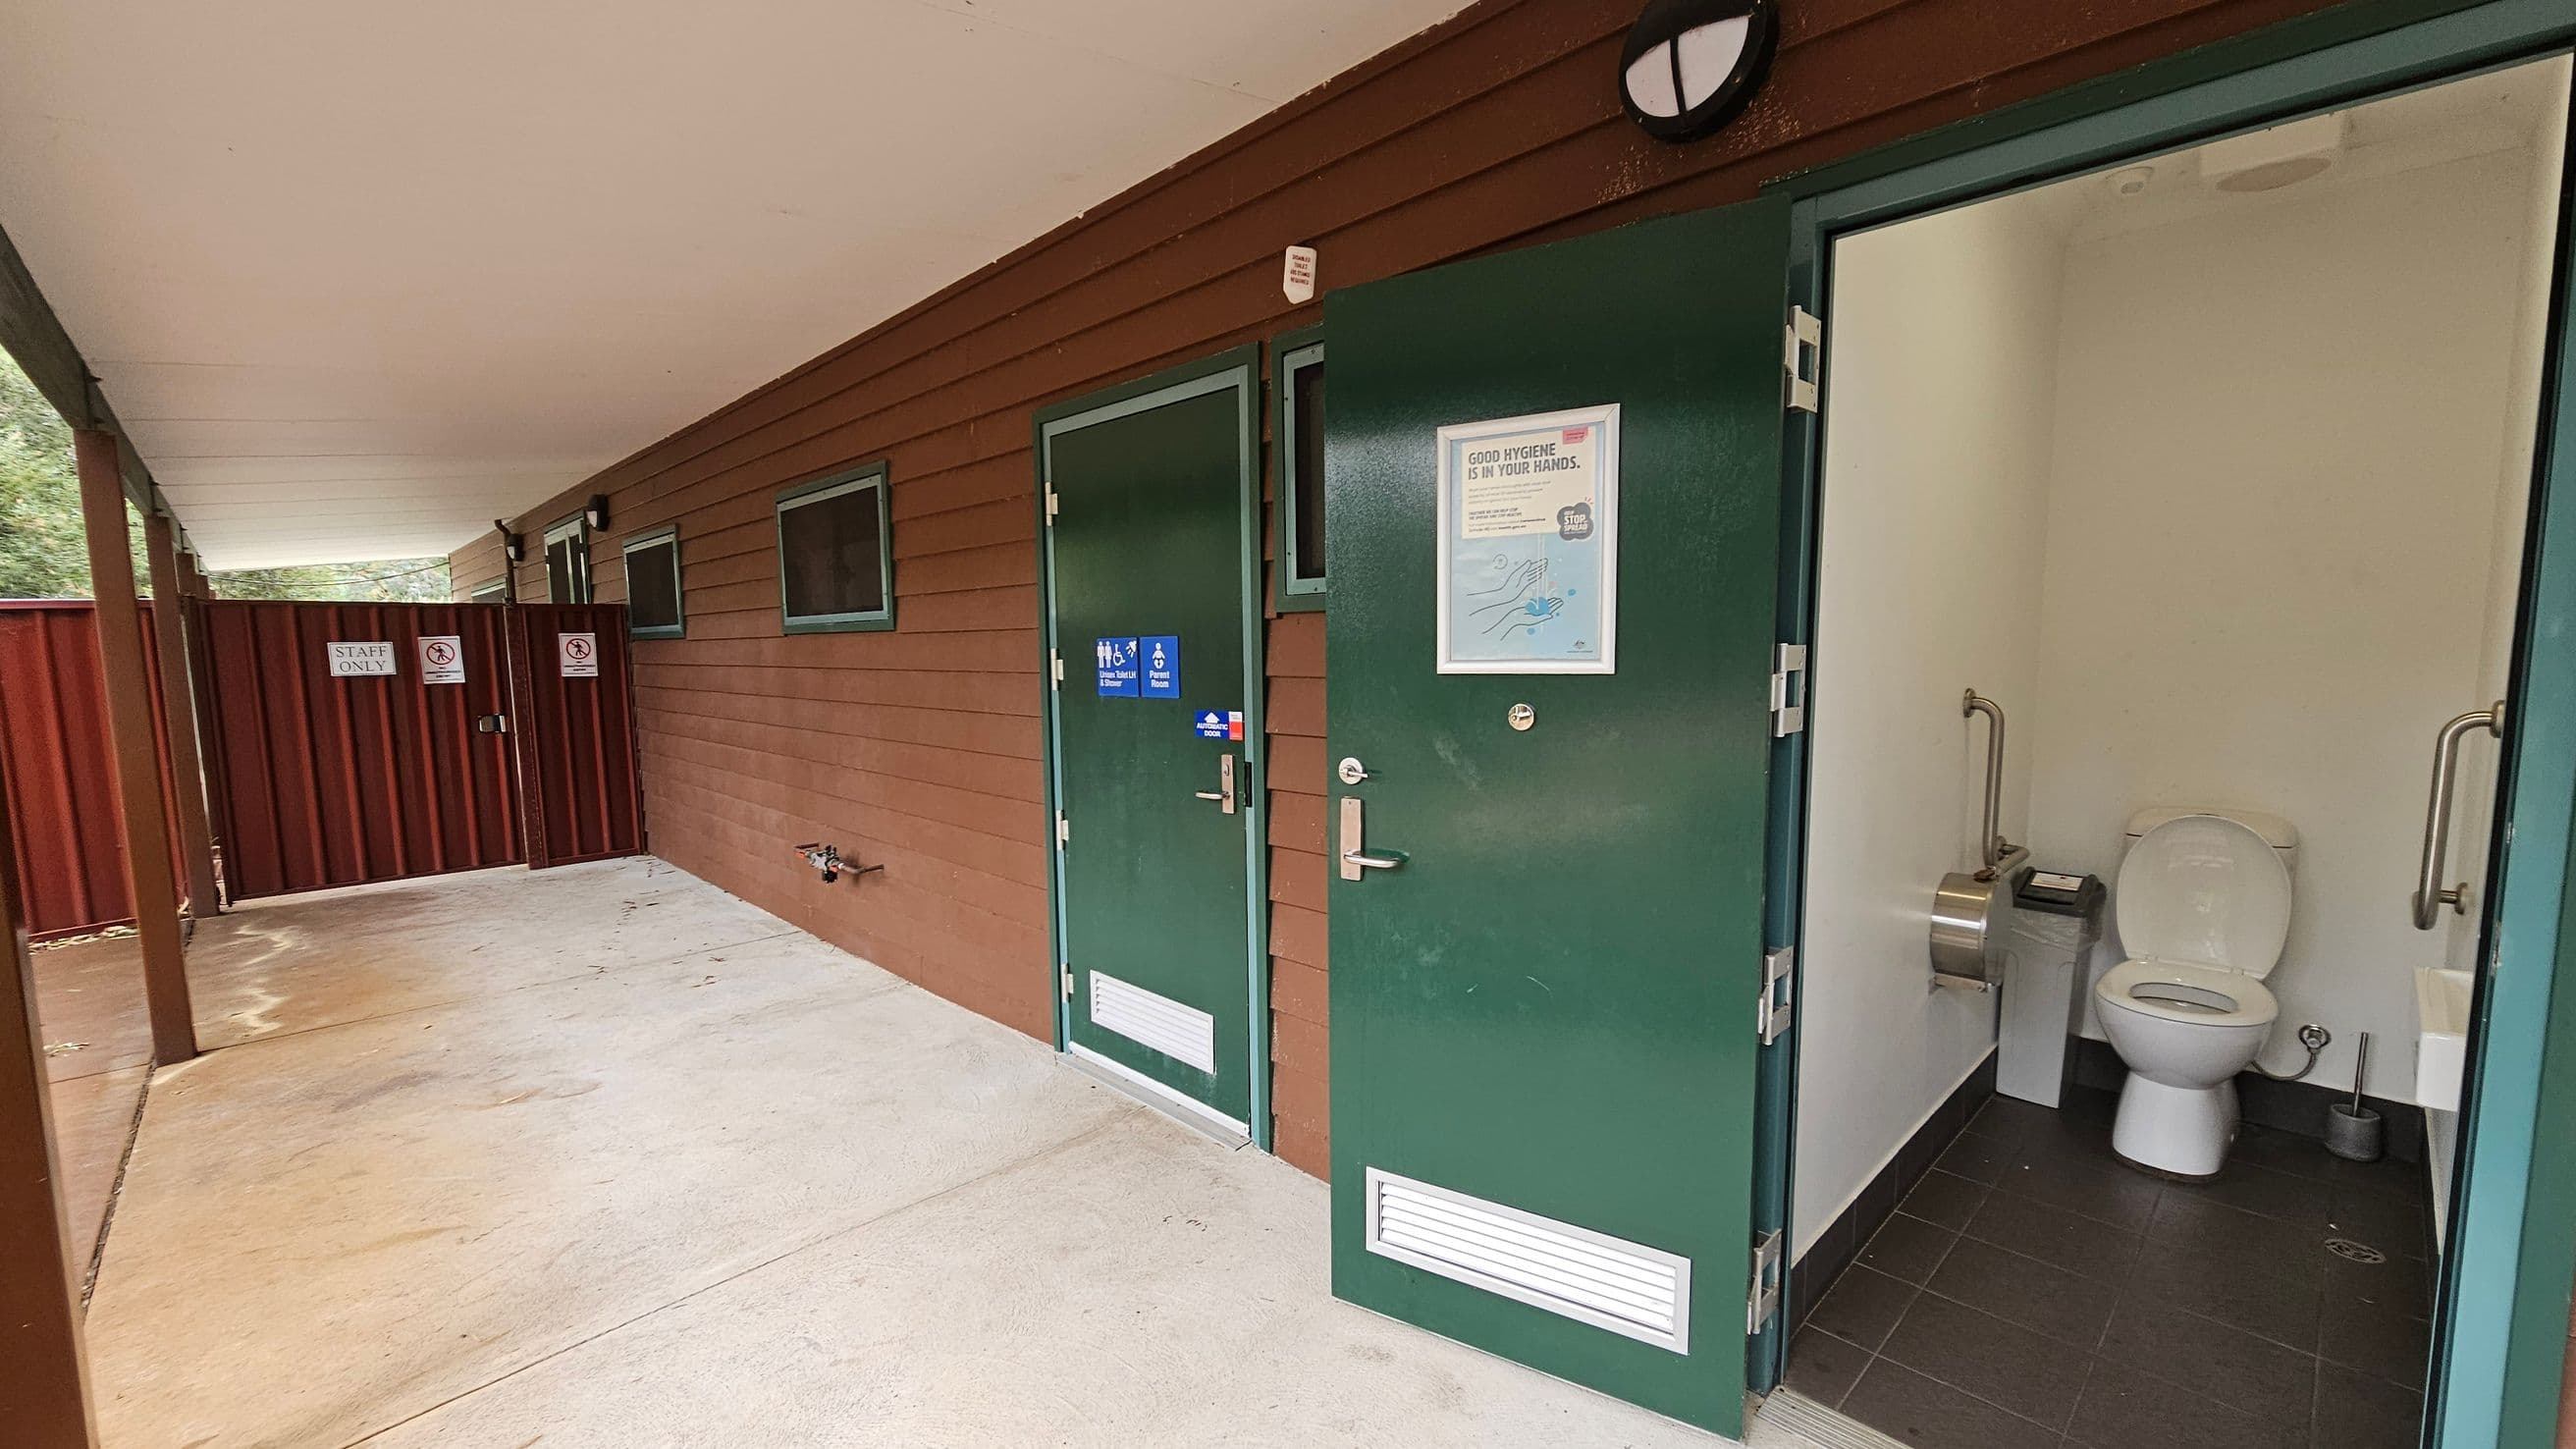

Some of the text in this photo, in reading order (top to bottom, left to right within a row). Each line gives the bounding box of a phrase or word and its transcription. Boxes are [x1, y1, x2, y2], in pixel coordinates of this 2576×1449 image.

[1468, 443, 1556, 464] GOOD HYGIENE
[1468, 456, 1581, 480] IS IN YOUR HANDS.
[1564, 514, 1585, 525] STOP
[336, 646, 387, 658] STAFF
[340, 661, 386, 672] ONLY
[1149, 670, 1170, 678] Parent
[1152, 679, 1169, 688] Room
